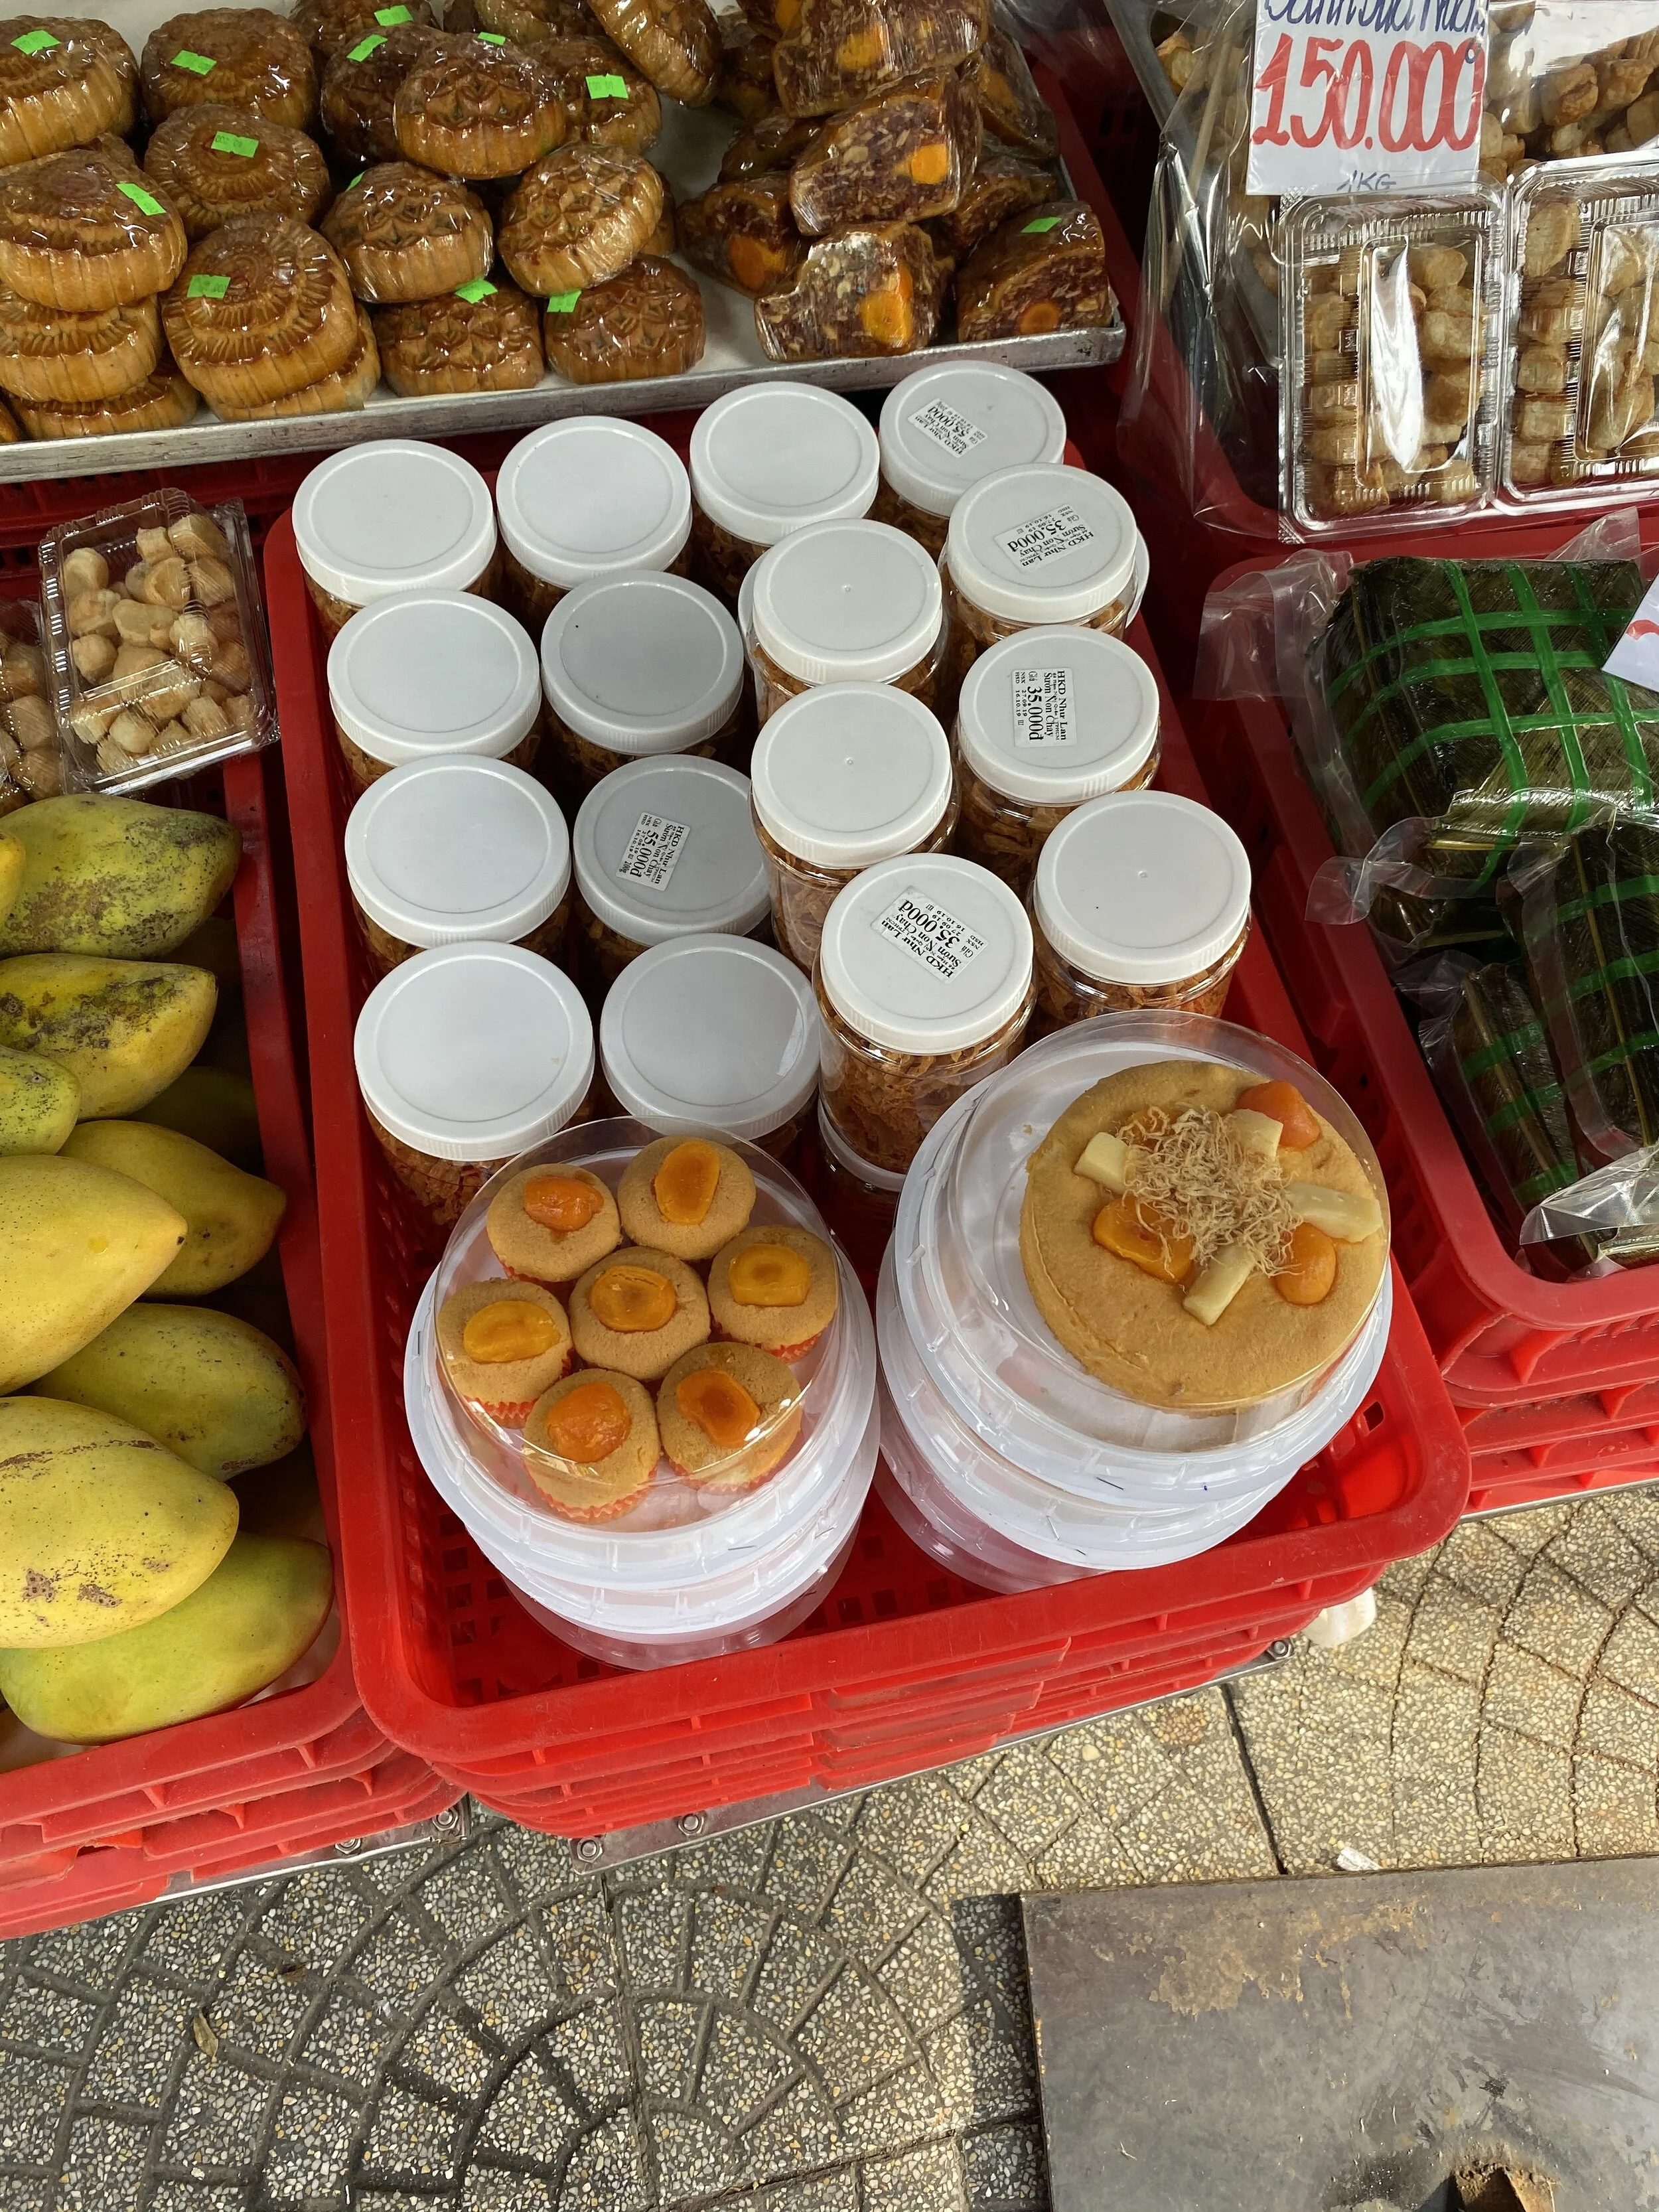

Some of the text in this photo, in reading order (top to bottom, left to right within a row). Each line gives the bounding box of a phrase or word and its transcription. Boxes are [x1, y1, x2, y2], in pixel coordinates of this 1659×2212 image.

[1336, 170, 1397, 193] 1KG
[1006, 520, 1066, 552] 35.000đ
[1042, 534, 1064, 550] Non
[1068, 531, 1094, 546] HKD
[1019, 542, 1043, 560] Chay
[1021, 554, 1043, 566] Lan
[1056, 670, 1066, 695] HKD
[1027, 686, 1045, 741] 35.000đ
[1045, 695, 1057, 713] Non
[1043, 715, 1055, 737] Chay
[1059, 721, 1068, 740] Lan
[670, 825, 685, 847] HKD
[629, 829, 659, 877] 55.000đ
[652, 843, 668, 859] Non
[643, 859, 658, 878] Chay
[654, 867, 667, 884] Lan
[897, 899, 974, 958] Giá 35.000đ
[881, 919, 954, 978] HKD Như Lan
[893, 913, 962, 967] Sườn Non Chay
[966, 938, 980, 950] NSX
[970, 934, 984, 946] HSD
